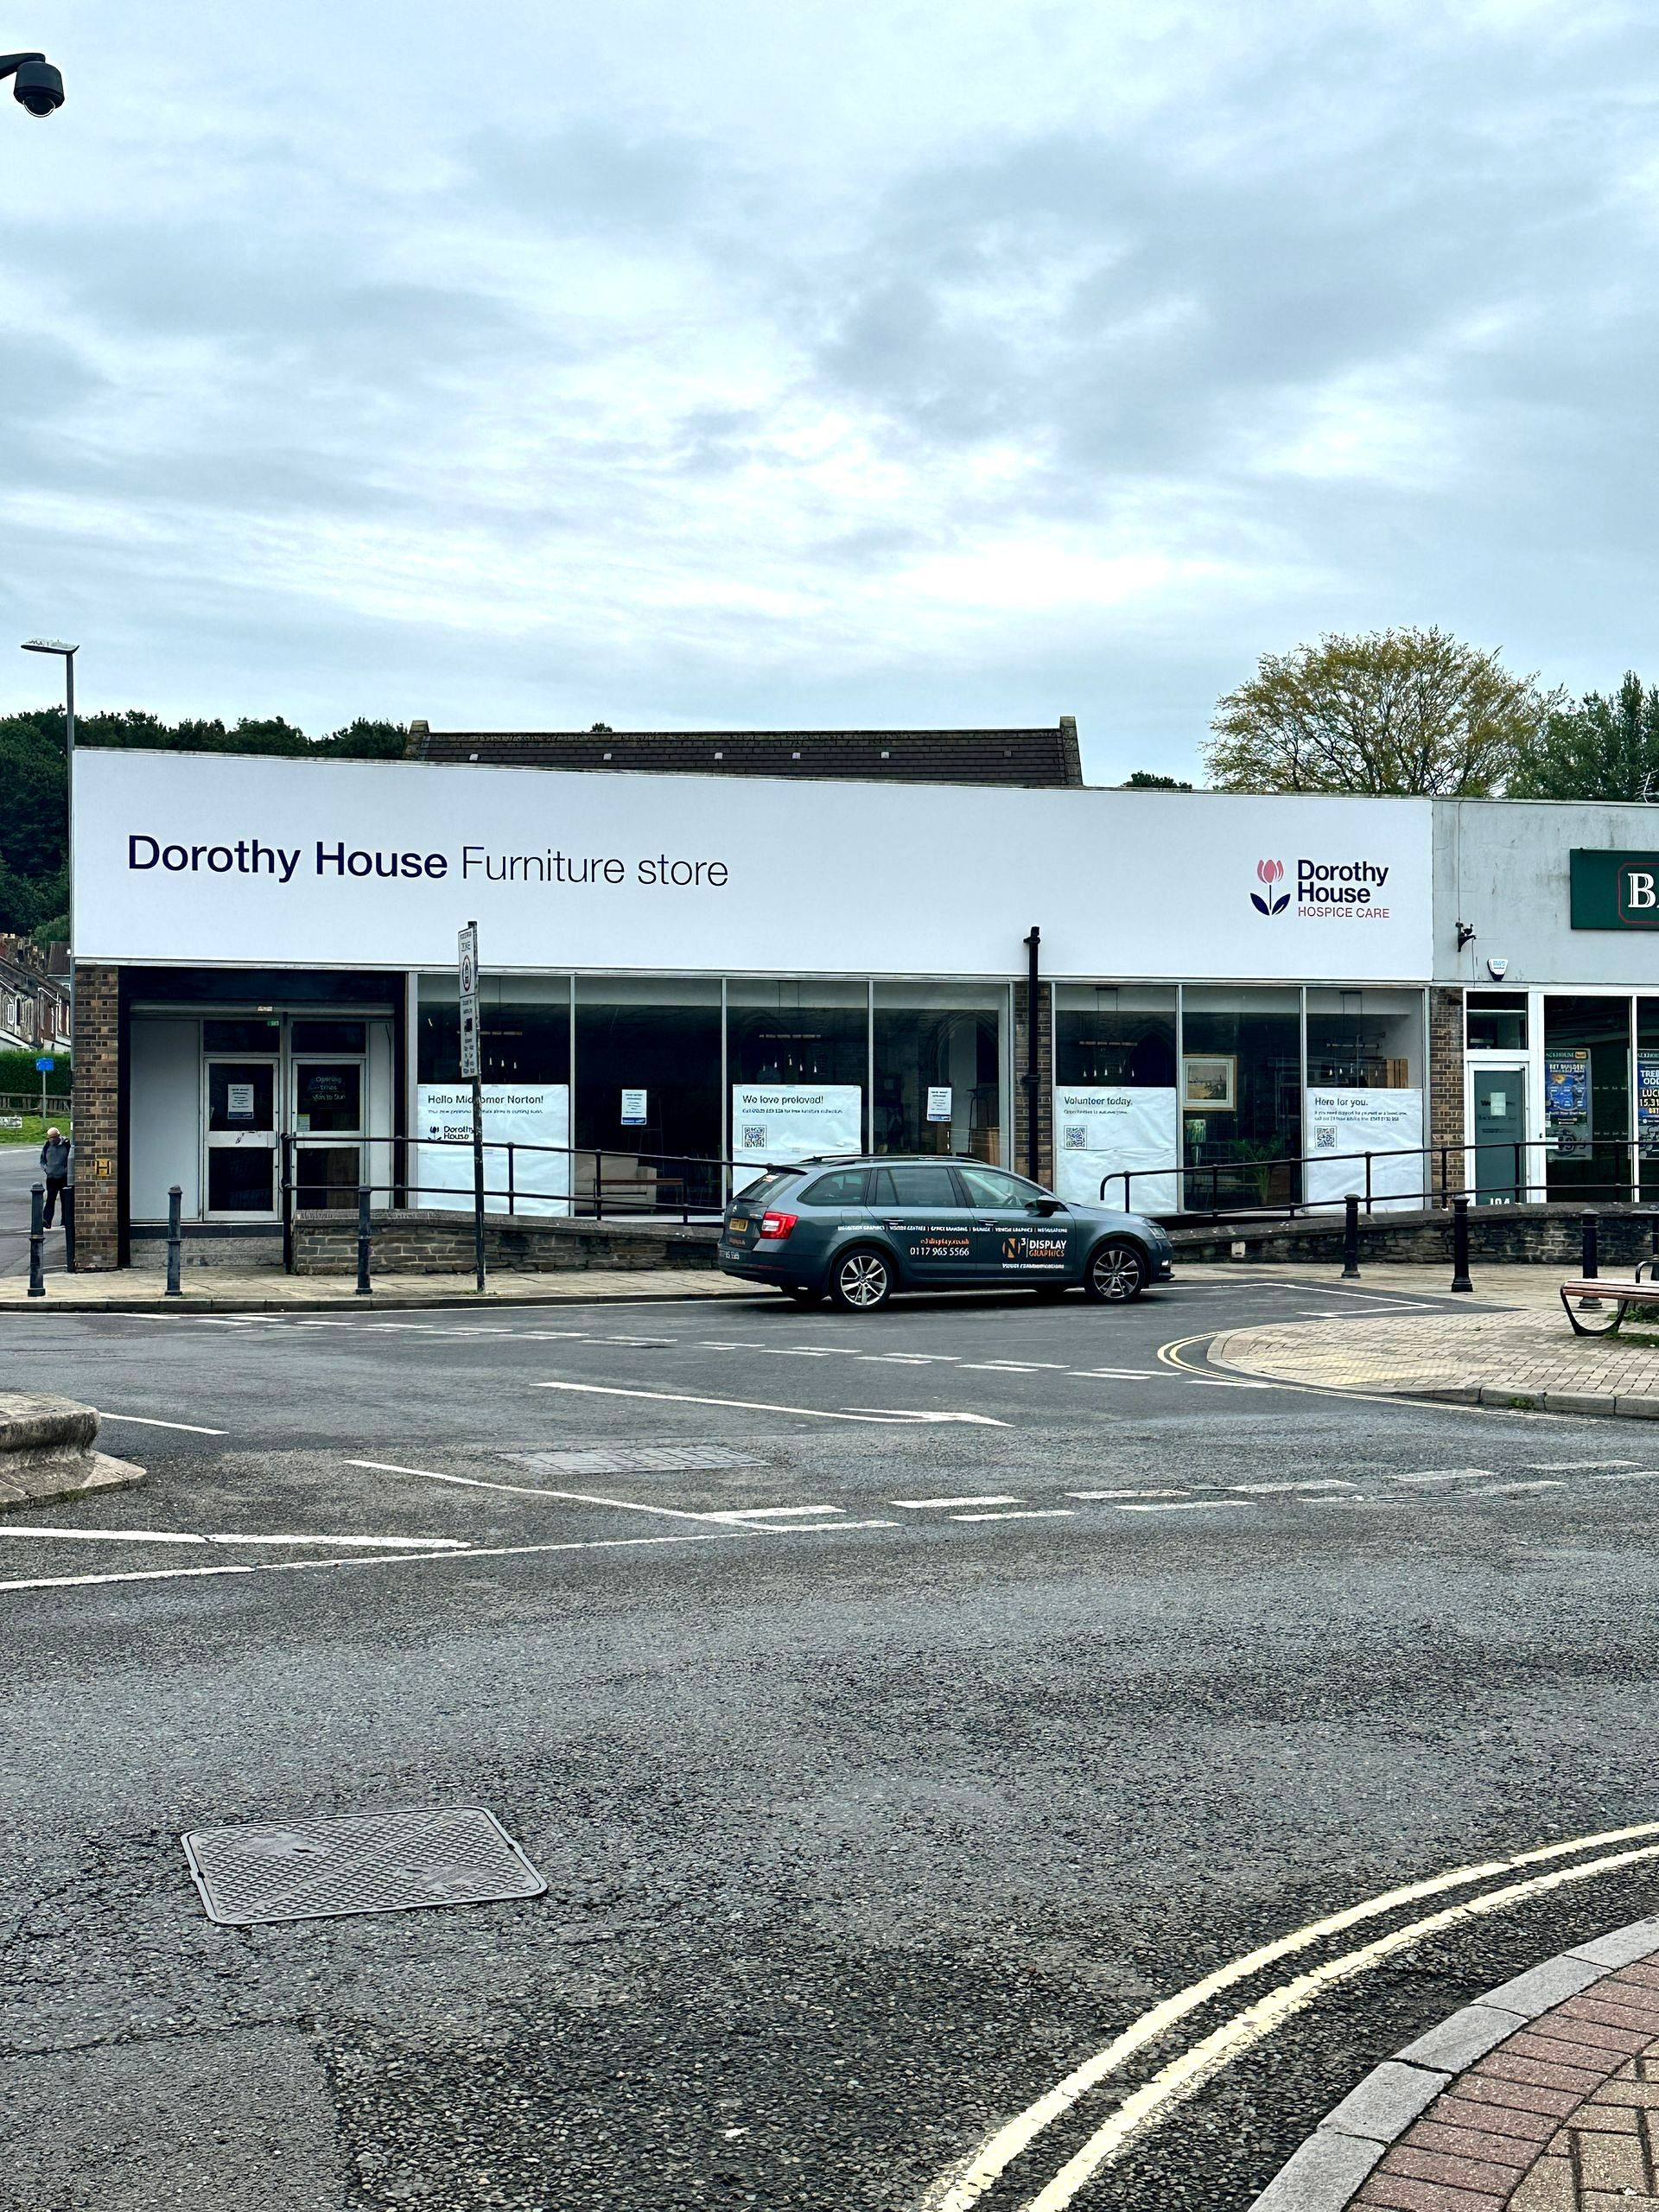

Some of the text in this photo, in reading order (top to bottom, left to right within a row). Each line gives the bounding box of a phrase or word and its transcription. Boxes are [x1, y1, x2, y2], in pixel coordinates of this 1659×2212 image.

[129, 835, 728, 887] Dorothy House Furniture store
[1297, 859, 1389, 887] Dorothy
[1297, 882, 1371, 904] House
[1297, 906, 1390, 918] HOSPICE CARE
[428, 1095, 453, 1104] Hello
[507, 1095, 543, 1104] Norton!
[742, 1095, 823, 1105] We love preloved!
[1064, 1096, 1133, 1107] Volunteer today.
[1314, 1097, 1369, 1108] Here for you.
[443, 1125, 474, 1135] Dorothy
[97, 1160, 110, 1175] H
[1029, 1239, 1067, 1249] DISPLAY
[910, 1247, 969, 1256] 0117 965 5566
[1028, 1249, 1065, 1257] GRAPHICS
